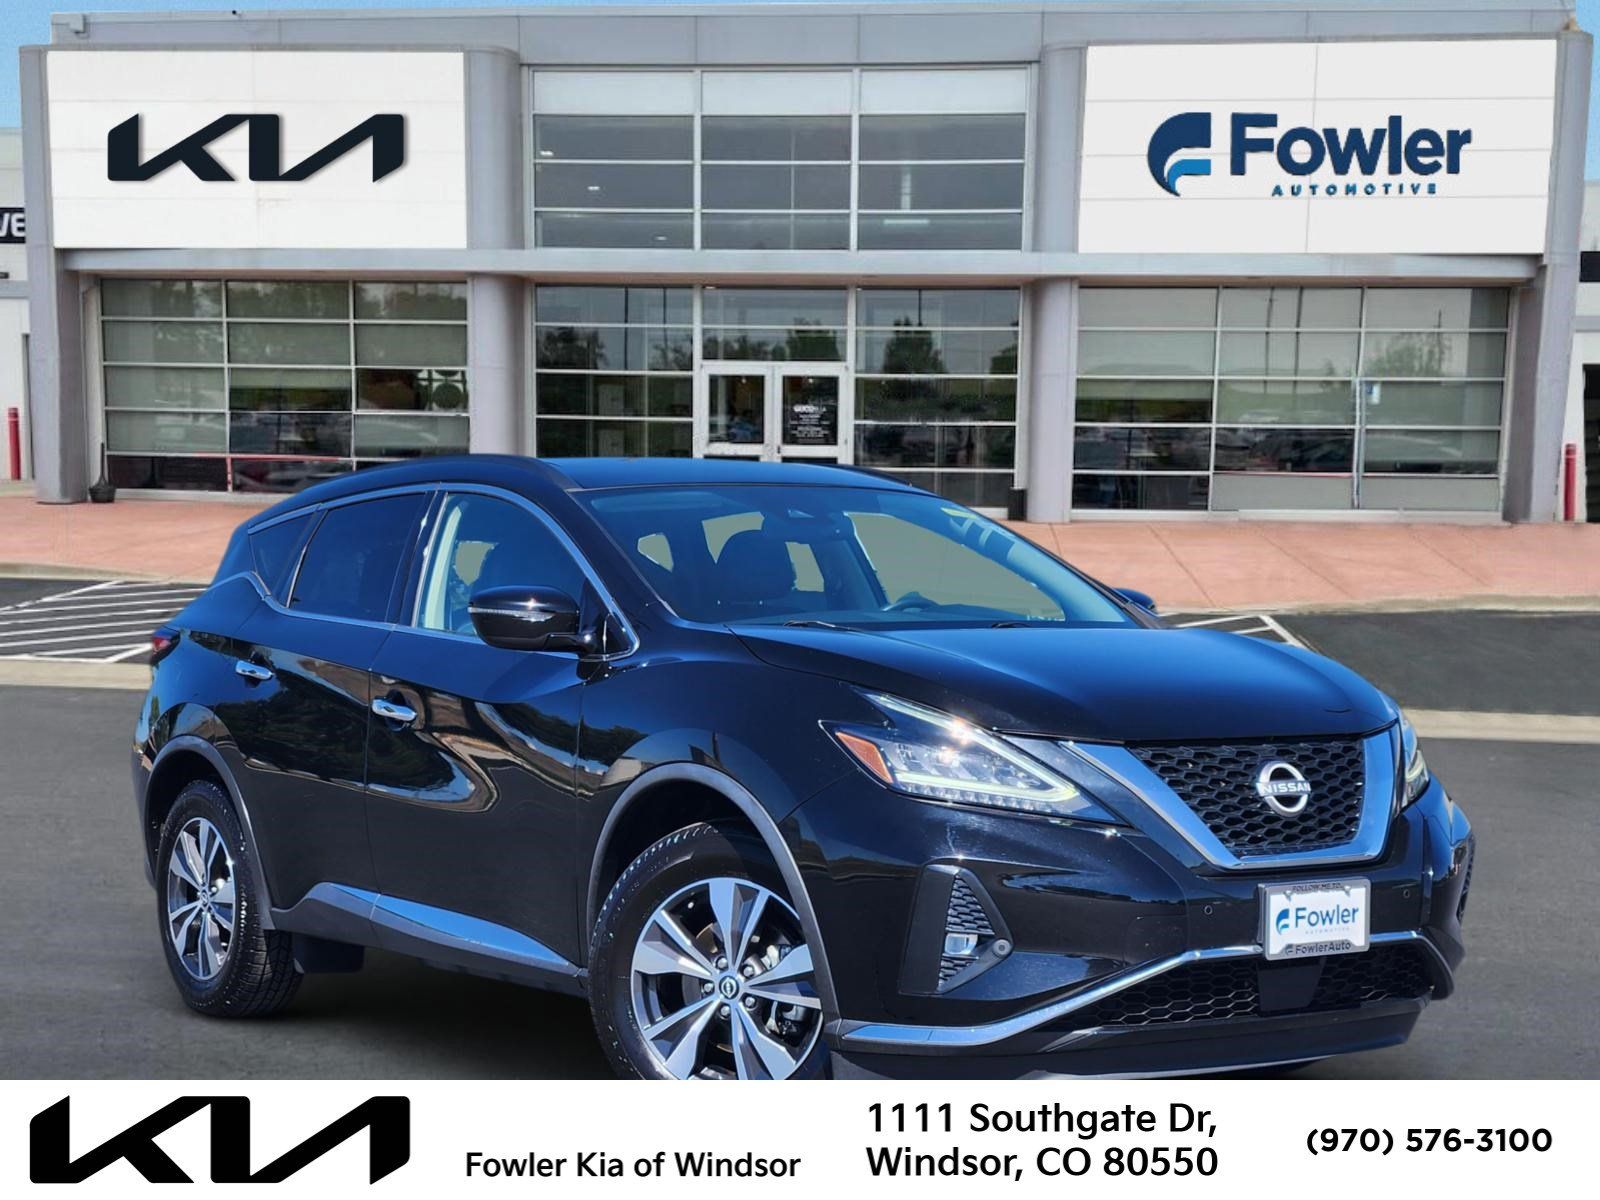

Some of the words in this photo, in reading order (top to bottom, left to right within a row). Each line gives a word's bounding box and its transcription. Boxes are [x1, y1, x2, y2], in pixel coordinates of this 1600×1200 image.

[1230, 112, 1472, 176] Fowler
[1271, 183, 1437, 197] AUTOMOTIVE
[1295, 904, 1359, 928] Fowler
[1295, 941, 1352, 954] FowlerAuto
